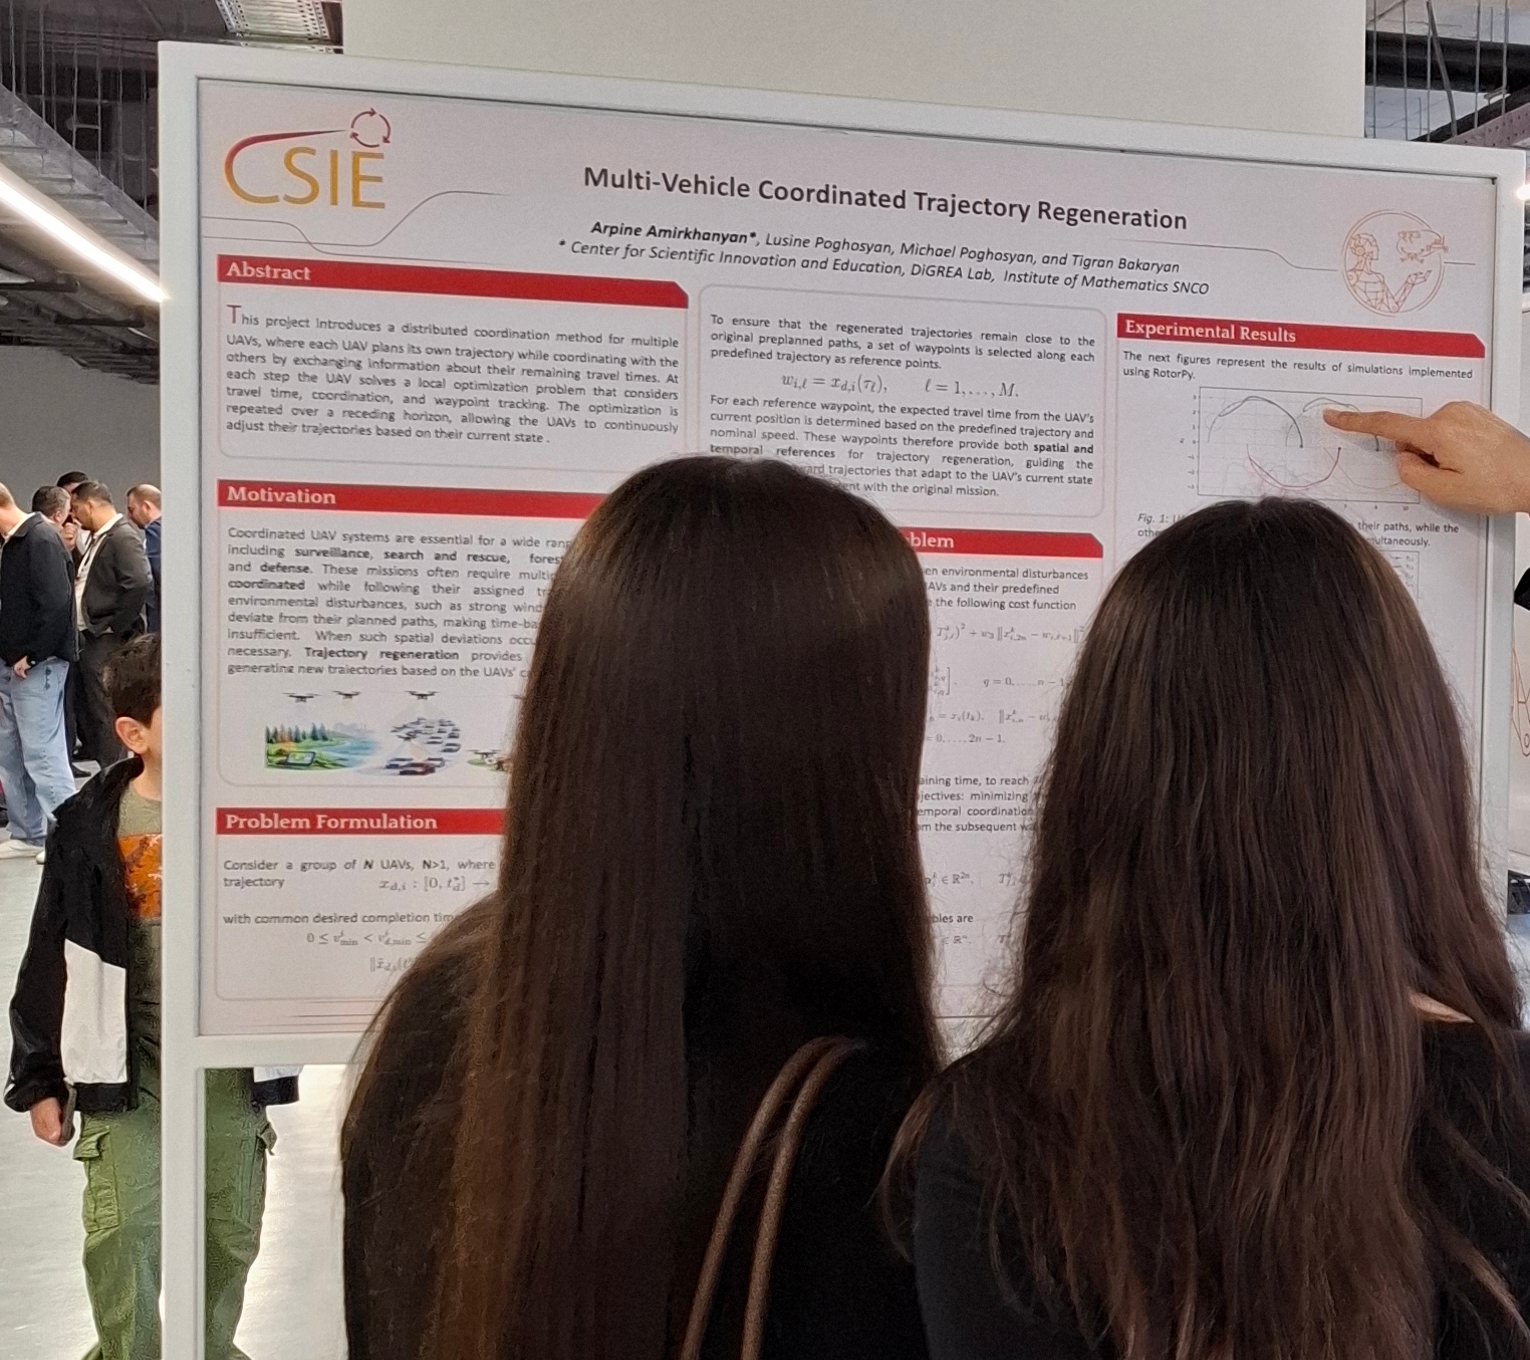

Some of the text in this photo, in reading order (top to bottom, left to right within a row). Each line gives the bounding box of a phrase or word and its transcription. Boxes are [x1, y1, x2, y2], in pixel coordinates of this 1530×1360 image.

[224, 129, 386, 209] CSIE
[584, 166, 1187, 229] Multi-Vehicle Coordinated Trajectory Regeneration
[591, 221, 642, 237] Arpine
[765, 232, 810, 248] Lusine
[814, 236, 894, 255] Poghosyan,
[900, 242, 956, 257] Michael
[959, 246, 1036, 265] Poghosyan,
[1041, 253, 1067, 265] and
[1072, 254, 1113, 270] Tigran
[1117, 257, 1179, 274] Bakaryan
[225, 261, 311, 280] Abstract
[571, 240, 1209, 295] Center for Scientific Innovation and Education, DiGREA Lab, Institute of Mathematics SNCO
[226, 304, 679, 349] This project introduces a distributed coordination method for multiple
[710, 313, 1095, 346] To ensure that the regenerated trajectories remain close to the
[1125, 319, 1295, 342] Experimental Results
[226, 334, 679, 367] UAVs, where each UAV plans its own trajectory while coordinating with the
[710, 331, 1095, 362] original preplanned paths, a set of waypoints is selected along each
[710, 347, 941, 369] predefined trajectory as reference points.
[1123, 350, 1473, 379] The next figures represent the results of simulations implemented
[1123, 366, 1195, 381] using RotorPy.
[709, 427, 1094, 454] nominal speed. These waypoints therefore provide both spatial and
[226, 485, 336, 504] Motivation
[863, 481, 999, 496] with the original mission.
[1138, 512, 1168, 525] Fig. 1:
[1357, 519, 1461, 533] their paths, while the
[228, 526, 506, 546] Coordinated UAV systems are essential for a
[941, 566, 1089, 580] environmental disturbances
[949, 582, 1059, 594] and their predefined
[935, 596, 1076, 610] the following cost function
[953, 775, 1029, 787] time, to reach
[970, 791, 1029, 803] minimizing
[225, 812, 438, 829] Problem Formulation
[934, 821, 1017, 833] the subsequent
[223, 859, 279, 870] Consider
[299, 861, 337, 872] group
[379, 859, 415, 871] UAVs,
[456, 859, 496, 869] where
[223, 876, 285, 889] trajectory
[223, 912, 430, 924] with common desired completion
[956, 915, 974, 923] are
